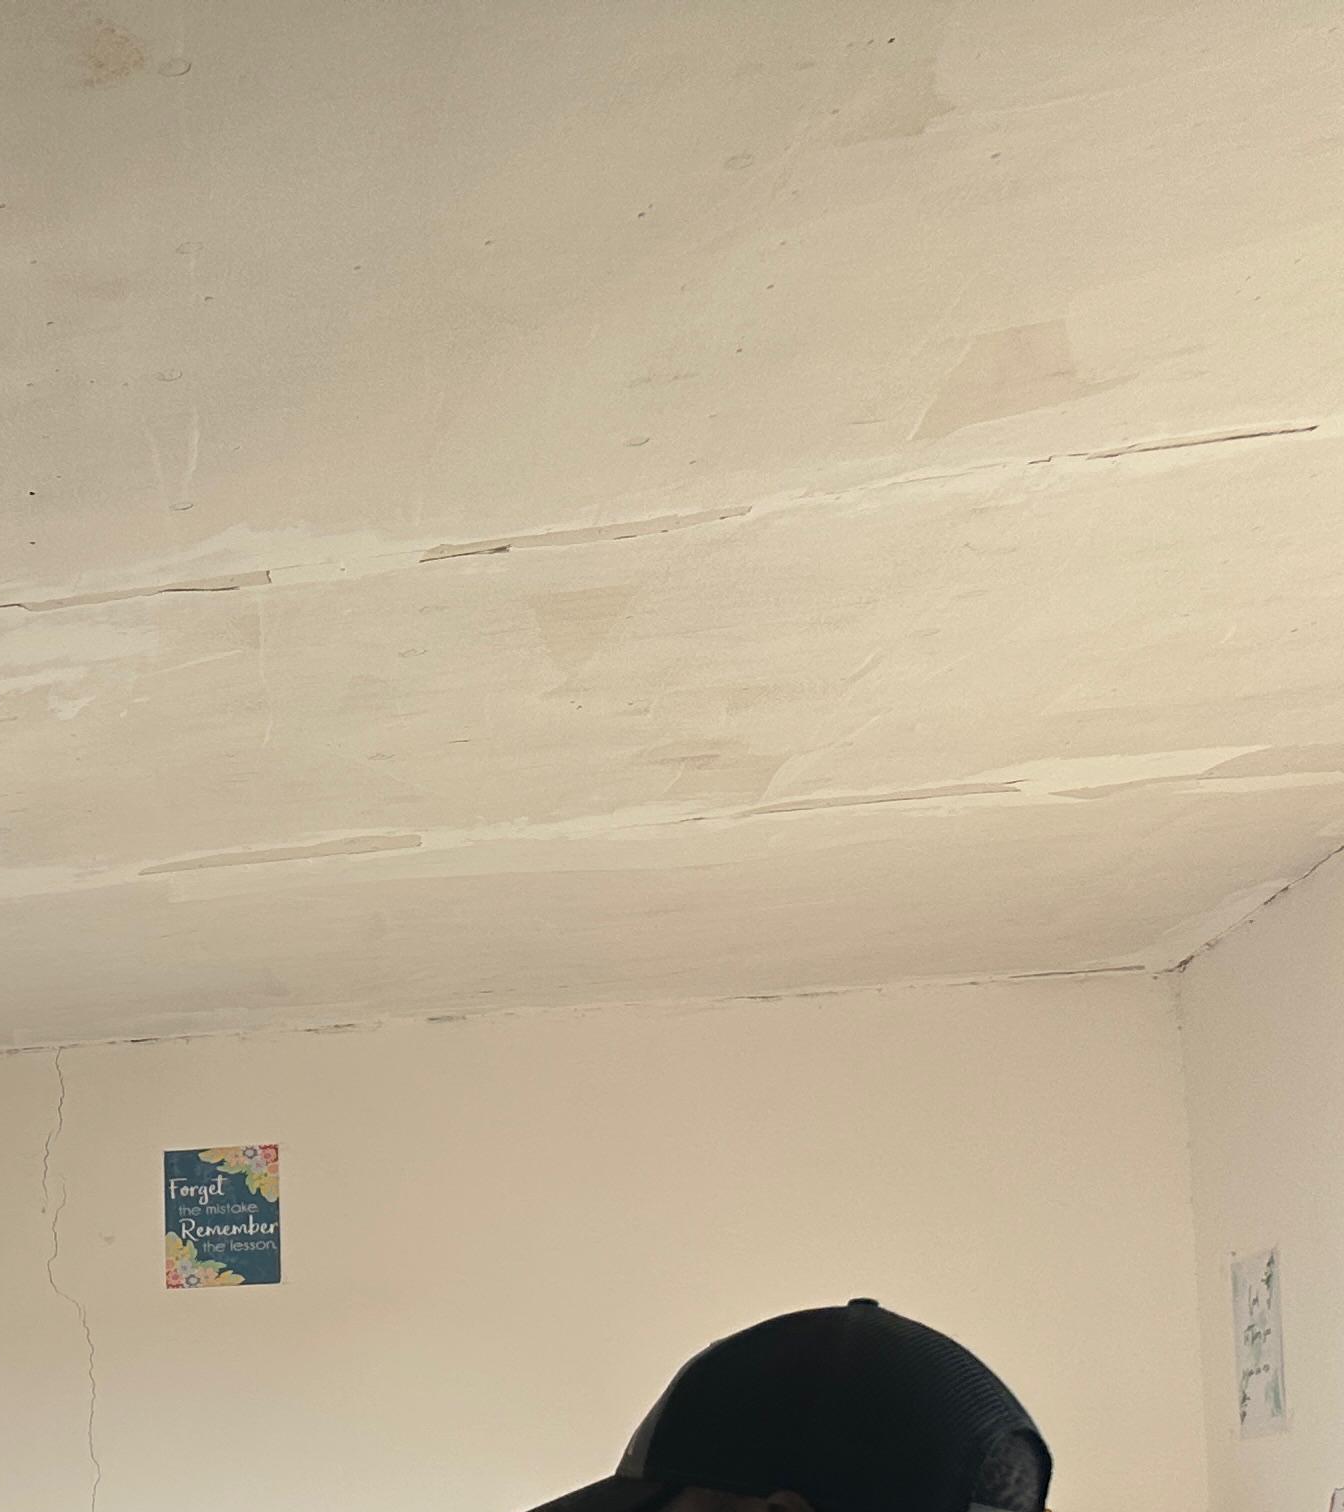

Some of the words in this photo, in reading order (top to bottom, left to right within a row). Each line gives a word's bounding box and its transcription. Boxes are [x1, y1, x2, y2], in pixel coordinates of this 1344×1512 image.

[169, 1174, 228, 1205] Forget
[179, 1204, 201, 1216] the
[179, 1215, 279, 1241] Remember
[203, 1241, 225, 1252] the
